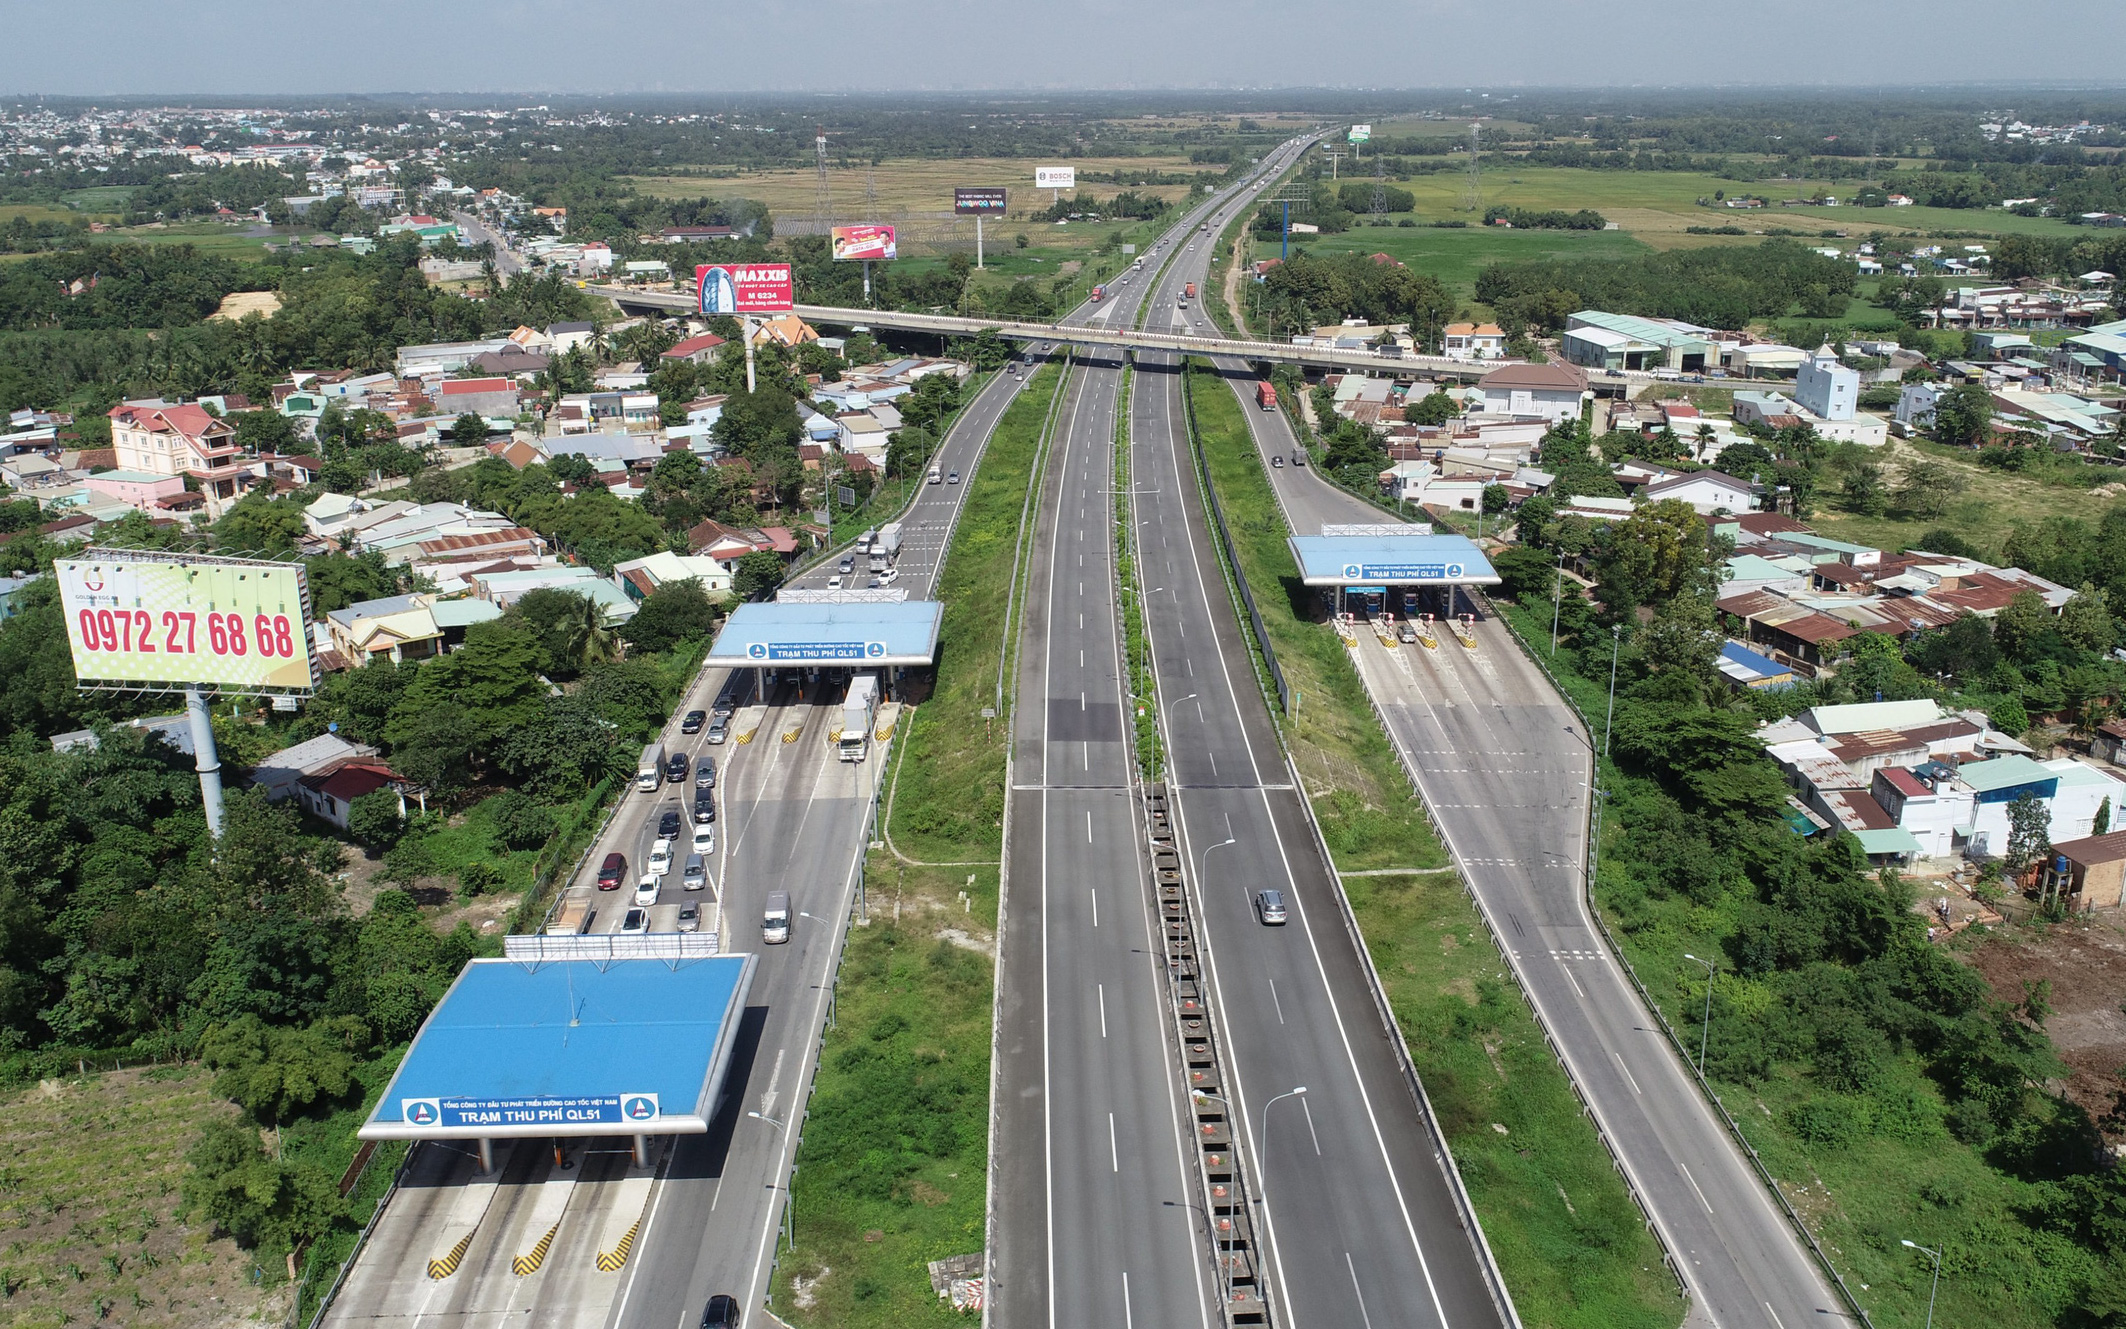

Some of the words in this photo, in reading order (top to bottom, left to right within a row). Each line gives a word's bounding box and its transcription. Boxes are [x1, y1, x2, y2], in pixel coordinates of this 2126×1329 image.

[735, 270, 788, 281] MAXXIS
[1407, 569, 1420, 577] PHÍ
[79, 608, 157, 653] 0972
[162, 611, 196, 654] 27
[207, 612, 248, 657] 68
[254, 614, 294, 659] 68
[777, 650, 801, 659] TRẠM
[821, 648, 836, 657] PHÍ
[443, 1100, 460, 1109] TỔNG
[460, 1101, 478, 1109] CÔNG
[509, 1099, 524, 1107] PHÁT
[577, 1098, 590, 1106] TỐC
[590, 1099, 603, 1107] VIỆT
[458, 1111, 501, 1125] TRẠM
[504, 1110, 536, 1122] THU
[538, 1107, 563, 1121] PHÍ
[566, 1109, 601, 1121] QL51
